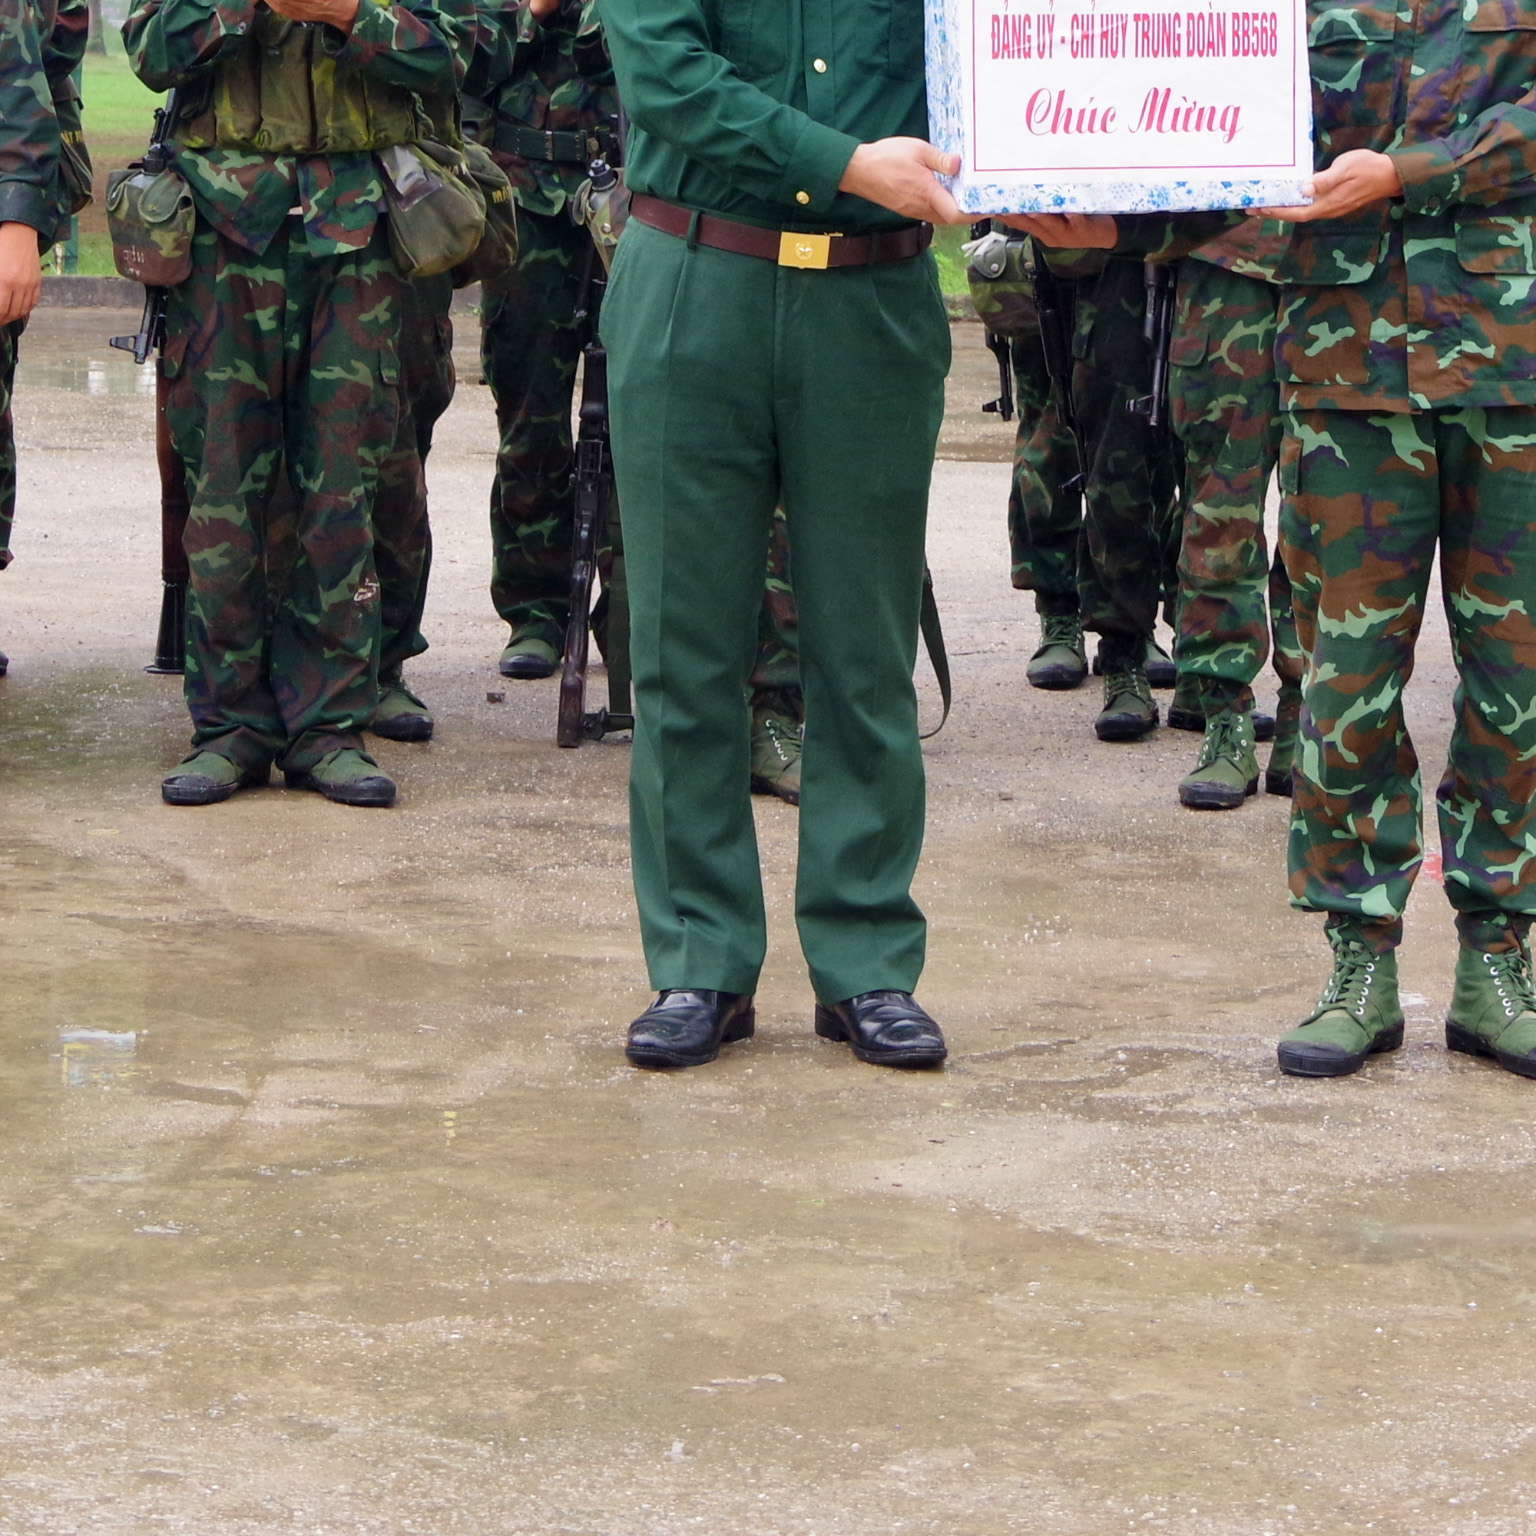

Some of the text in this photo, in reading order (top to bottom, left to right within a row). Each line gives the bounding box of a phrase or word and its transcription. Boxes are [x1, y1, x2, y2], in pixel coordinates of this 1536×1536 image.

[1100, 13, 1129, 59] HUY
[1133, 12, 1182, 58] TRUNG
[1185, 1, 1227, 58] ĐOÀN
[1231, 11, 1278, 58] BB568
[1024, 86, 1245, 145] Chúc Mừng
